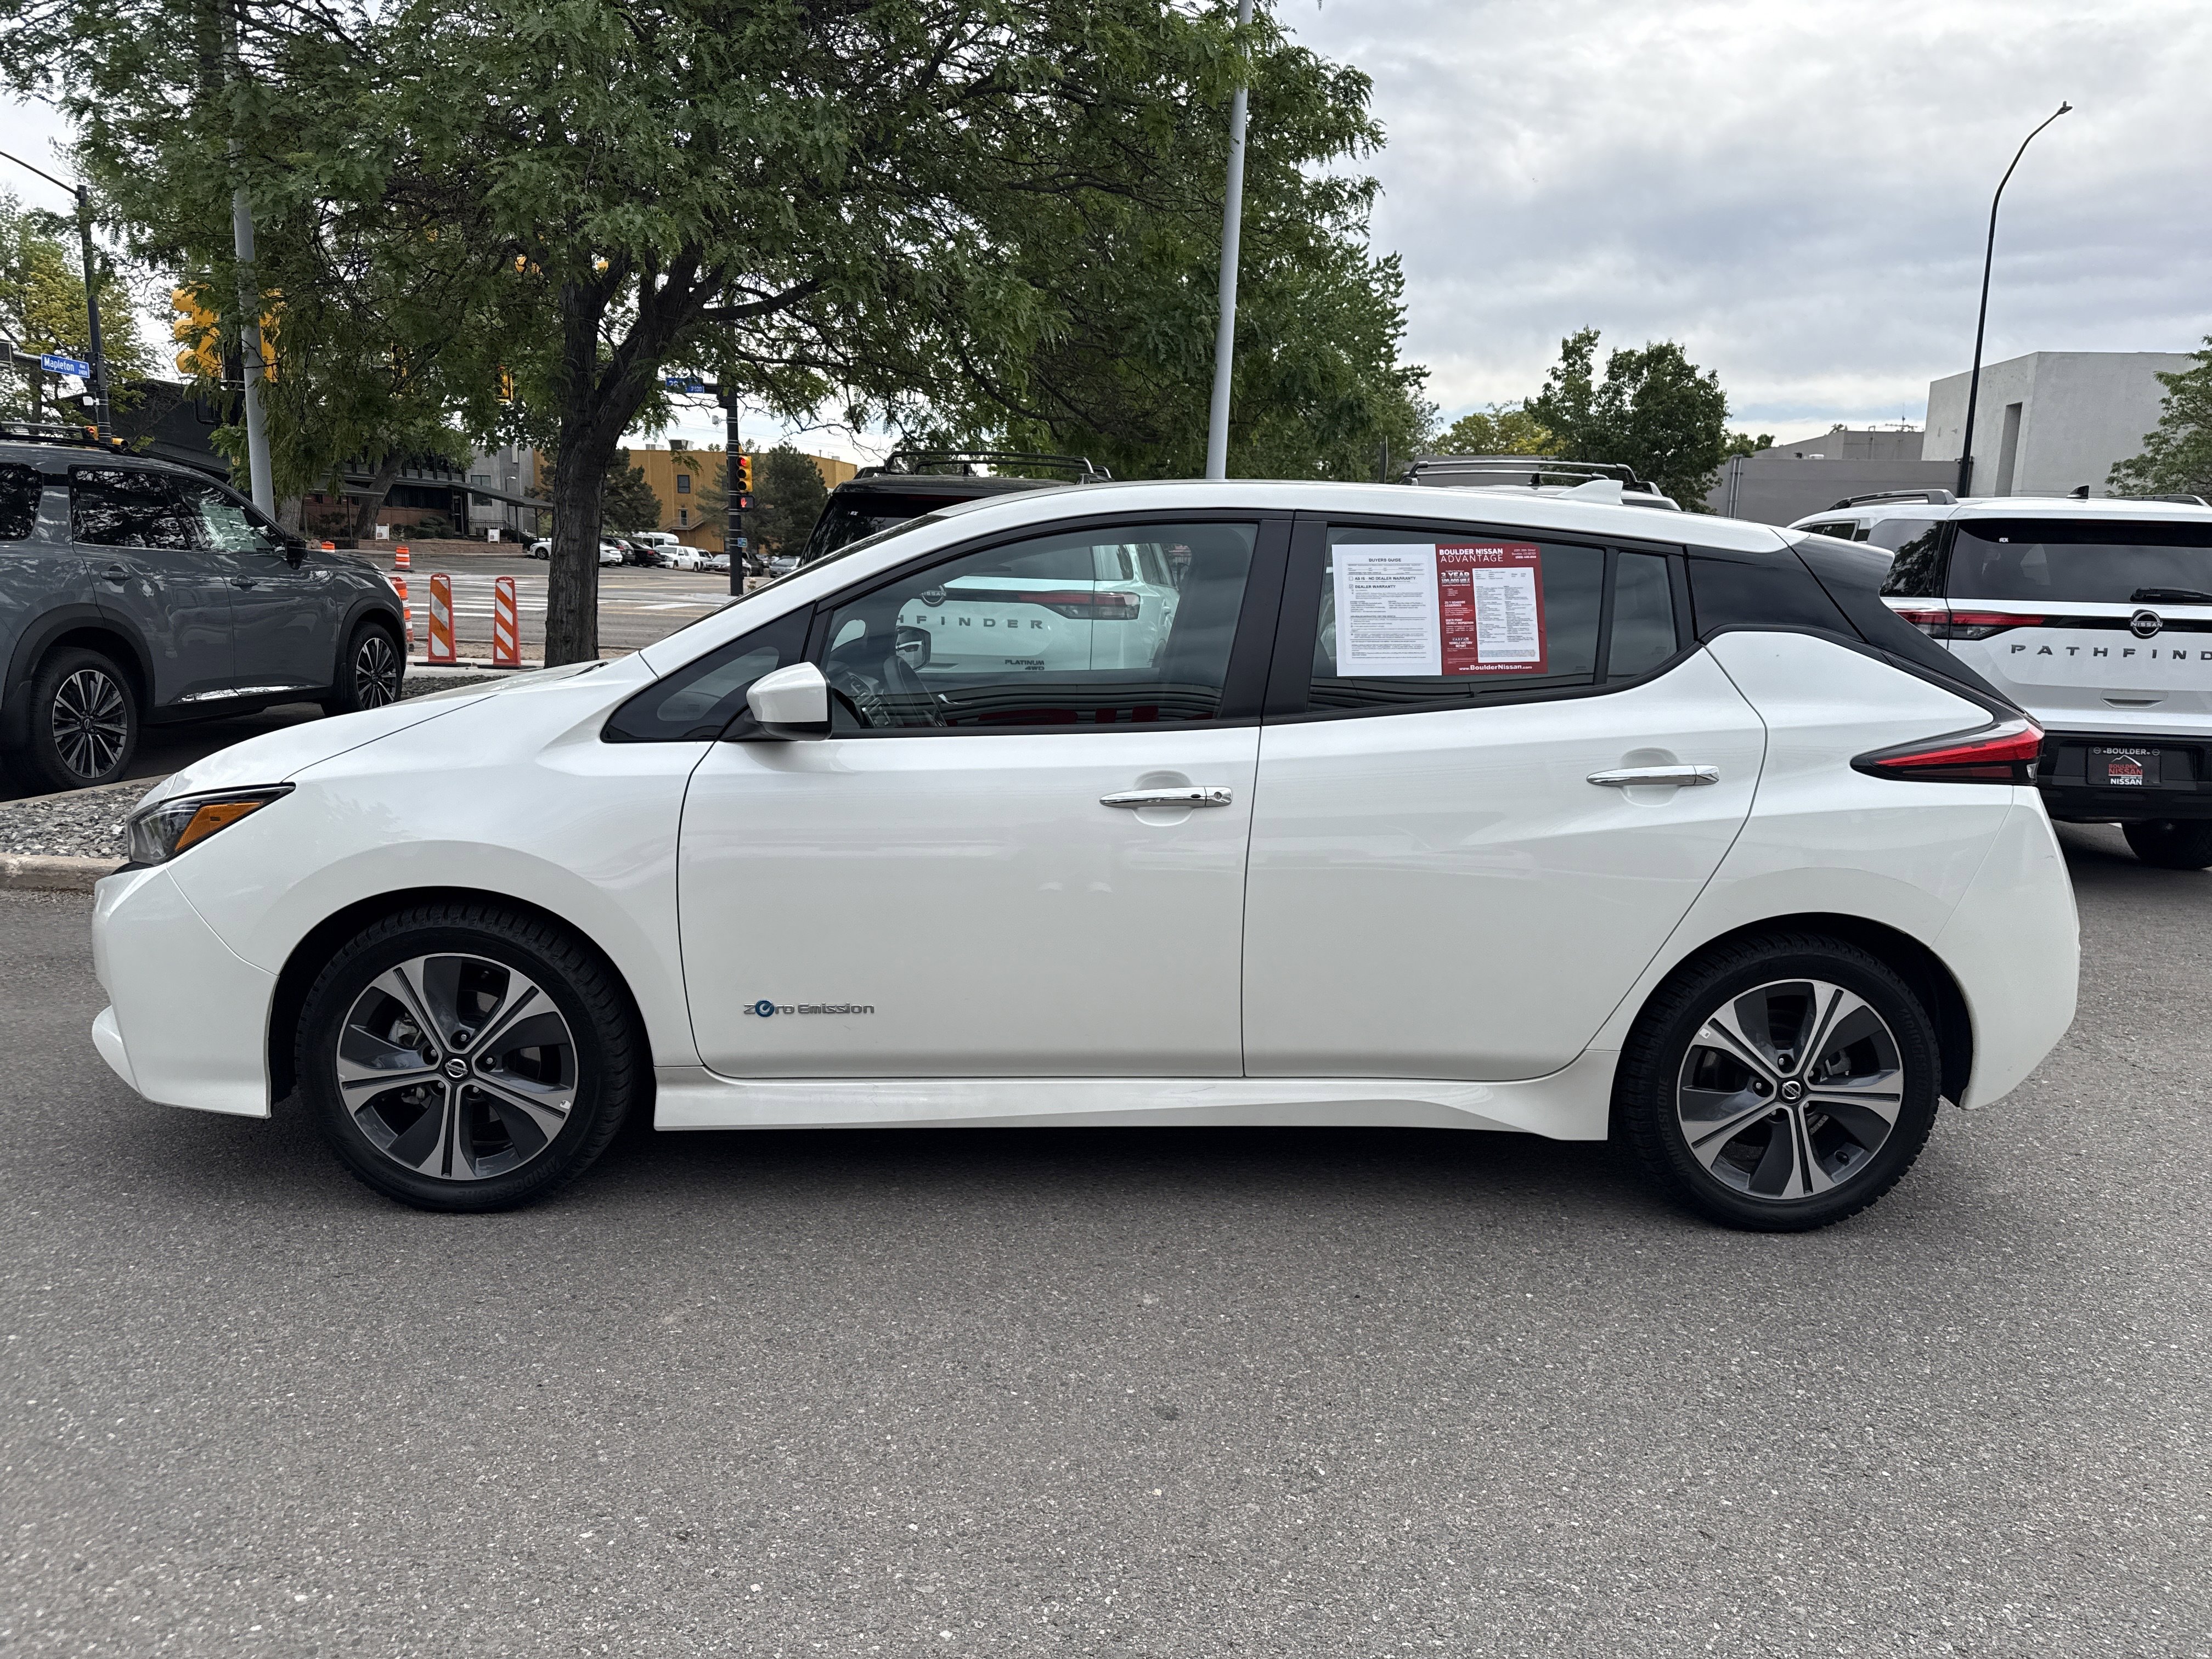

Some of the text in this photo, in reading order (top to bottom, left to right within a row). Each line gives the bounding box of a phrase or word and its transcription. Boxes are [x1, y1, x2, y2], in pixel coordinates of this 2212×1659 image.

[44, 357, 75, 371] Mapleton
[1440, 554, 1504, 563] ADVANTAGE
[798, 1002, 874, 1014] Emission
[1657, 1076, 1689, 1177] BRIDGESTONE
[455, 1154, 563, 1205] BRIDGESTONE
